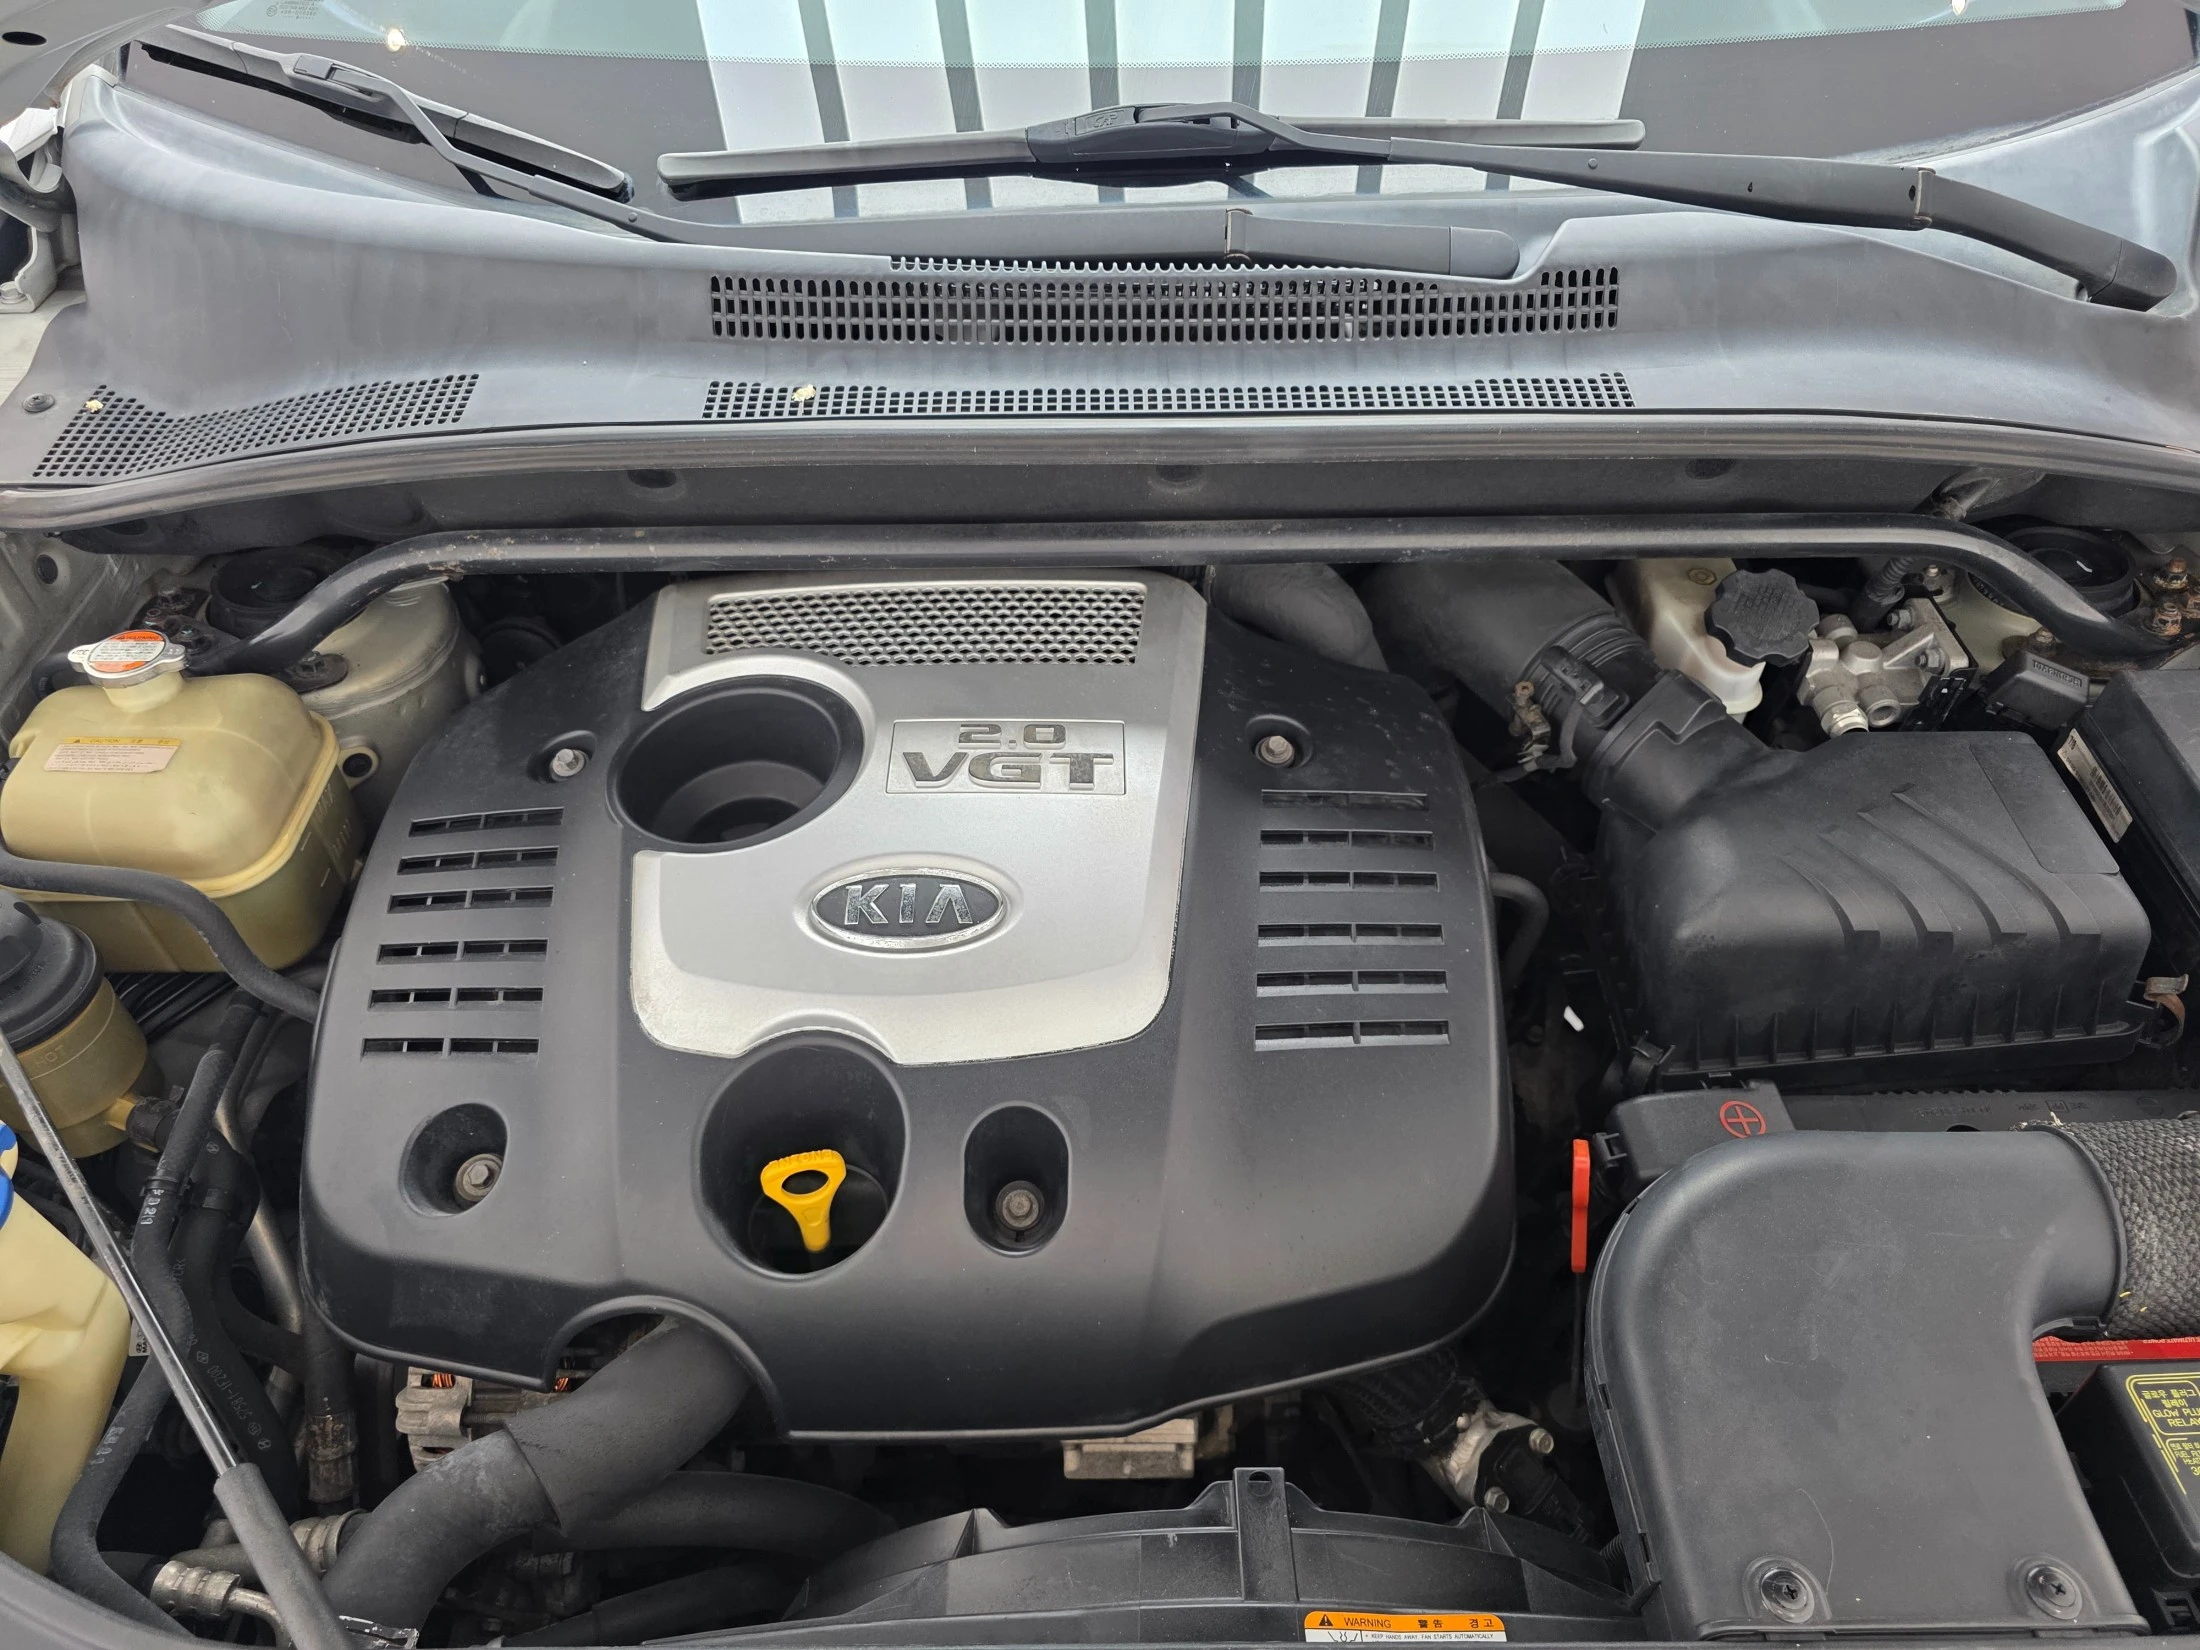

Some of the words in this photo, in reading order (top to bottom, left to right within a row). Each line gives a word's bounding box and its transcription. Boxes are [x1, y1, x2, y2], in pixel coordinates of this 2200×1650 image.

[958, 723, 1067, 749] 2.0
[902, 751, 1115, 790] VGT
[844, 883, 973, 925] KIA
[2152, 1409, 2180, 1418] GLOW
[1344, 1617, 1391, 1628] WARNING
